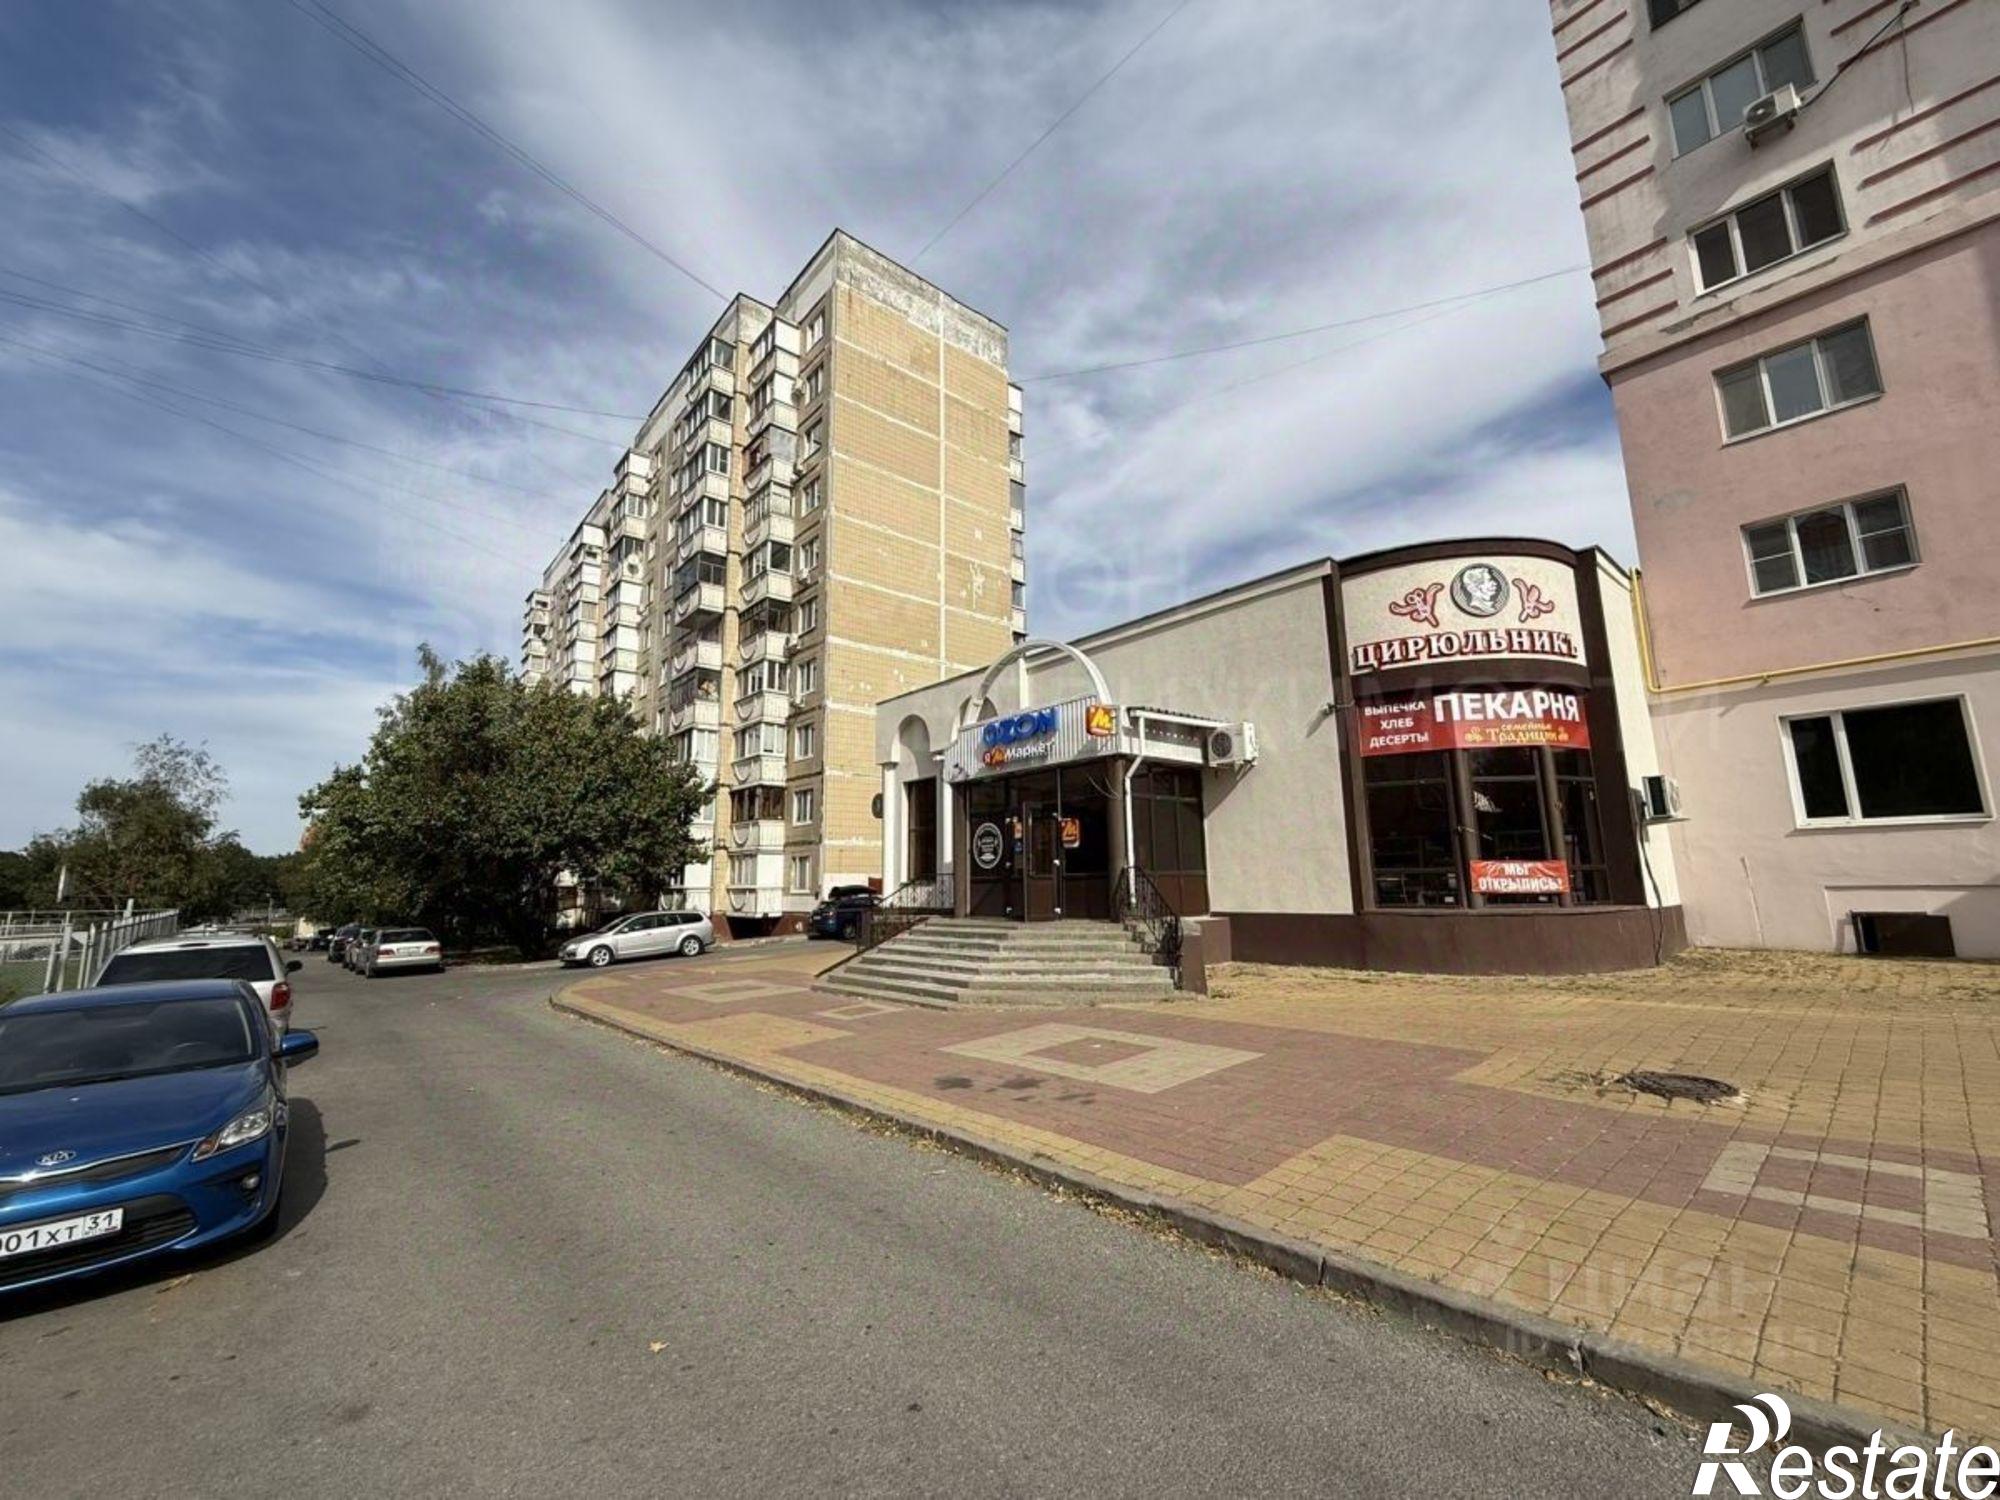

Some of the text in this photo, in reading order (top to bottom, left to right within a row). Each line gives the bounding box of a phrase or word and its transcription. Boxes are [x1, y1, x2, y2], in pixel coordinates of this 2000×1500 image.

[1364, 700, 1426, 716] ВЫПЕЧКА
[1433, 691, 1580, 722] ПЕКАРНЯ
[983, 707, 1056, 745] OZON
[1380, 718, 1414, 730] ХЛЕБ
[1369, 732, 1429, 749] ДЕСЕРТЫ
[88, 1213, 114, 1230] 31
